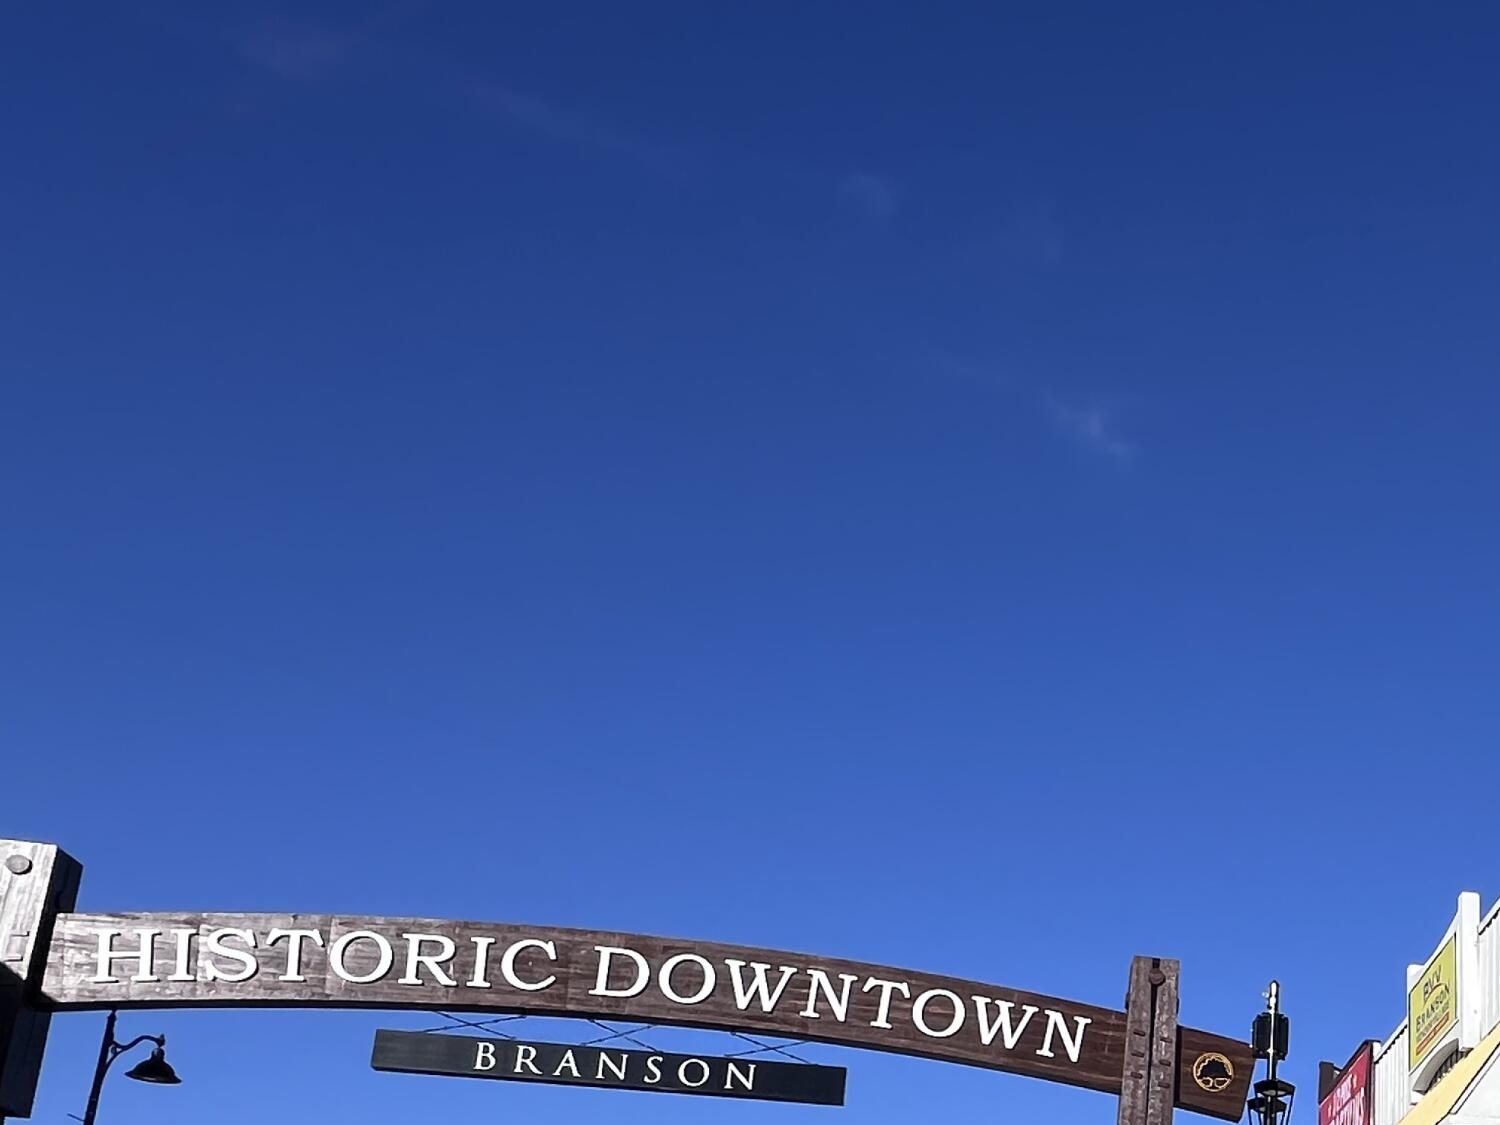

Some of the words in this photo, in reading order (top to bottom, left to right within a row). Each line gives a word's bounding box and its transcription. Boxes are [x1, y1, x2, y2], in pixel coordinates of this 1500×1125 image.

[88, 926, 558, 992] HISTORIC
[587, 944, 1092, 1063] DOWNTOWN
[473, 1041, 757, 1091] BRANSON
